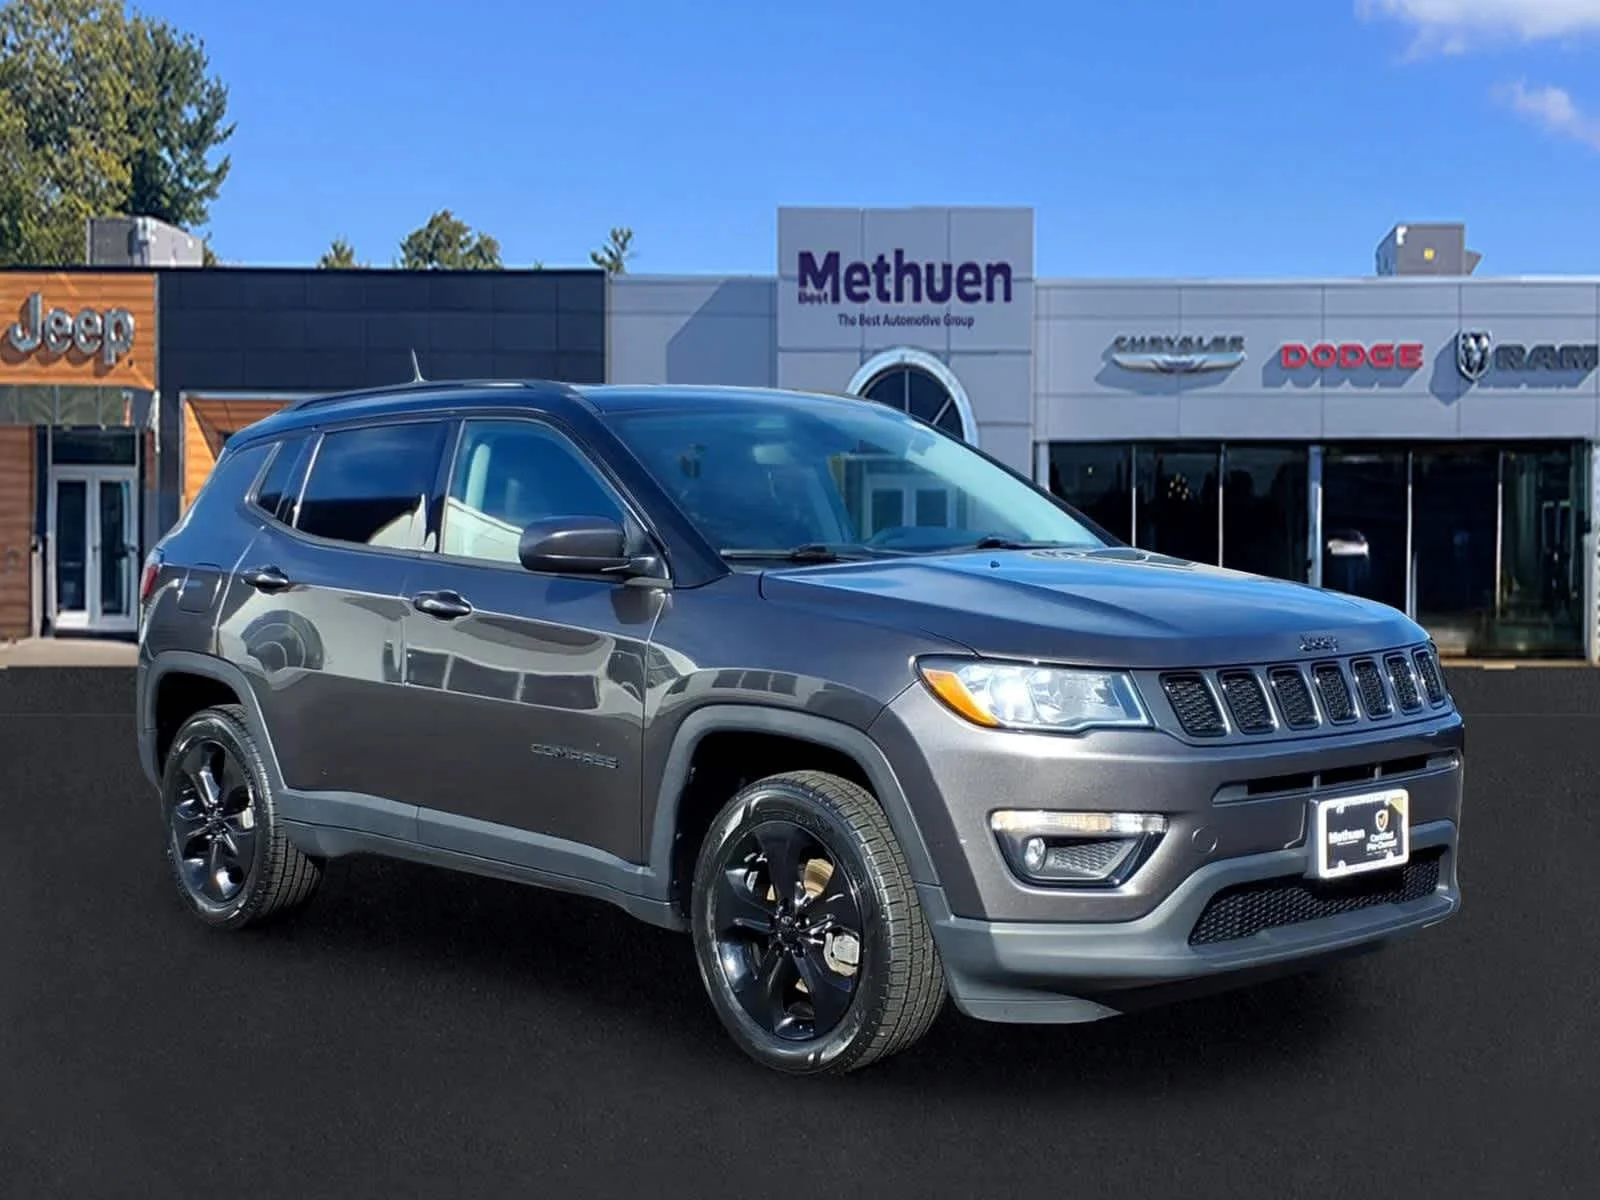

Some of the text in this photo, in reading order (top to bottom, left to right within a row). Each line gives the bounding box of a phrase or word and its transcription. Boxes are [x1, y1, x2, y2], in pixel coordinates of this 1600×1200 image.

[798, 248, 1012, 303] Methuen
[8, 291, 135, 366] Jeep
[838, 313, 974, 329] The Best Automotive Group
[1114, 335, 1245, 353] CHRYSLER
[1281, 343, 1424, 369] DODGE
[1494, 343, 1598, 370] RAM
